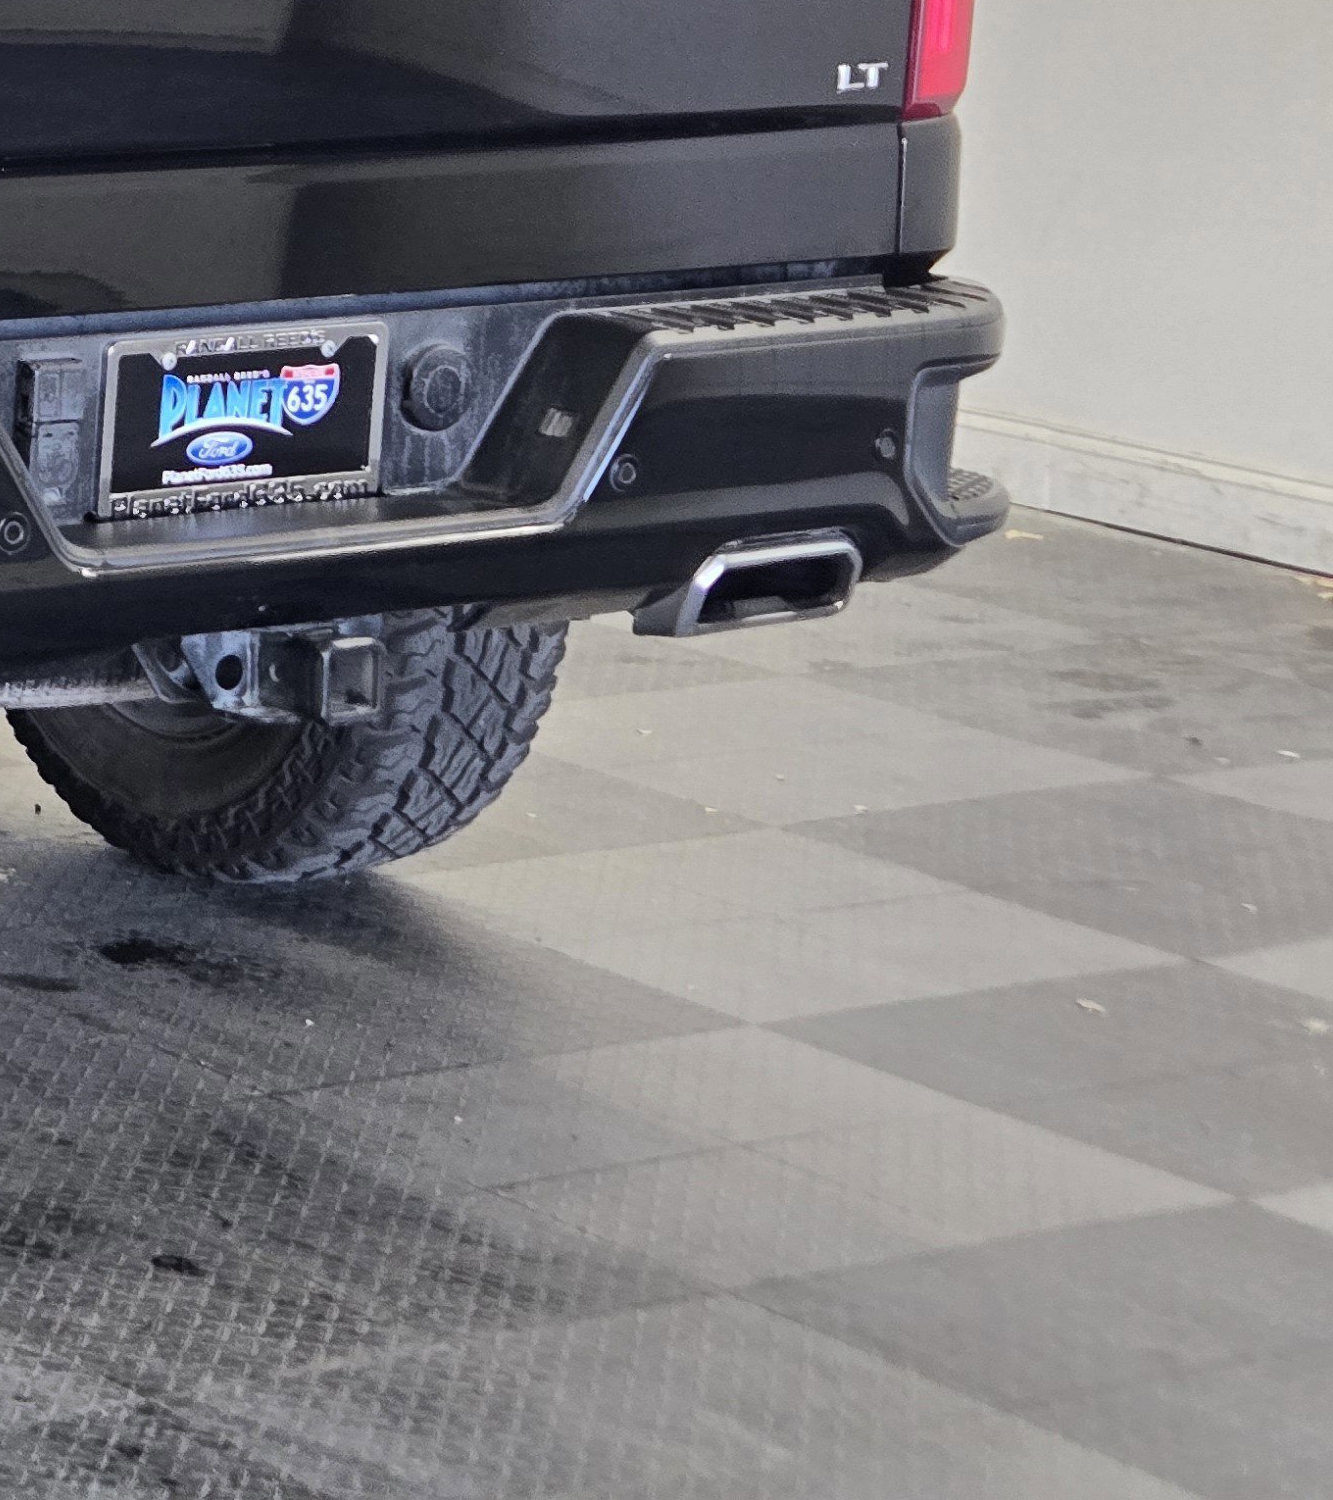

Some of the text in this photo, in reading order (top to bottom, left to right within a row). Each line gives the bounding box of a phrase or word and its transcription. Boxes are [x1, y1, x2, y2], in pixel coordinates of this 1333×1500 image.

[836, 61, 889, 94] LT
[175, 334, 259, 356] RANDALL
[158, 373, 290, 441] PLANET
[287, 383, 329, 413] 635
[199, 438, 239, 459] Ford
